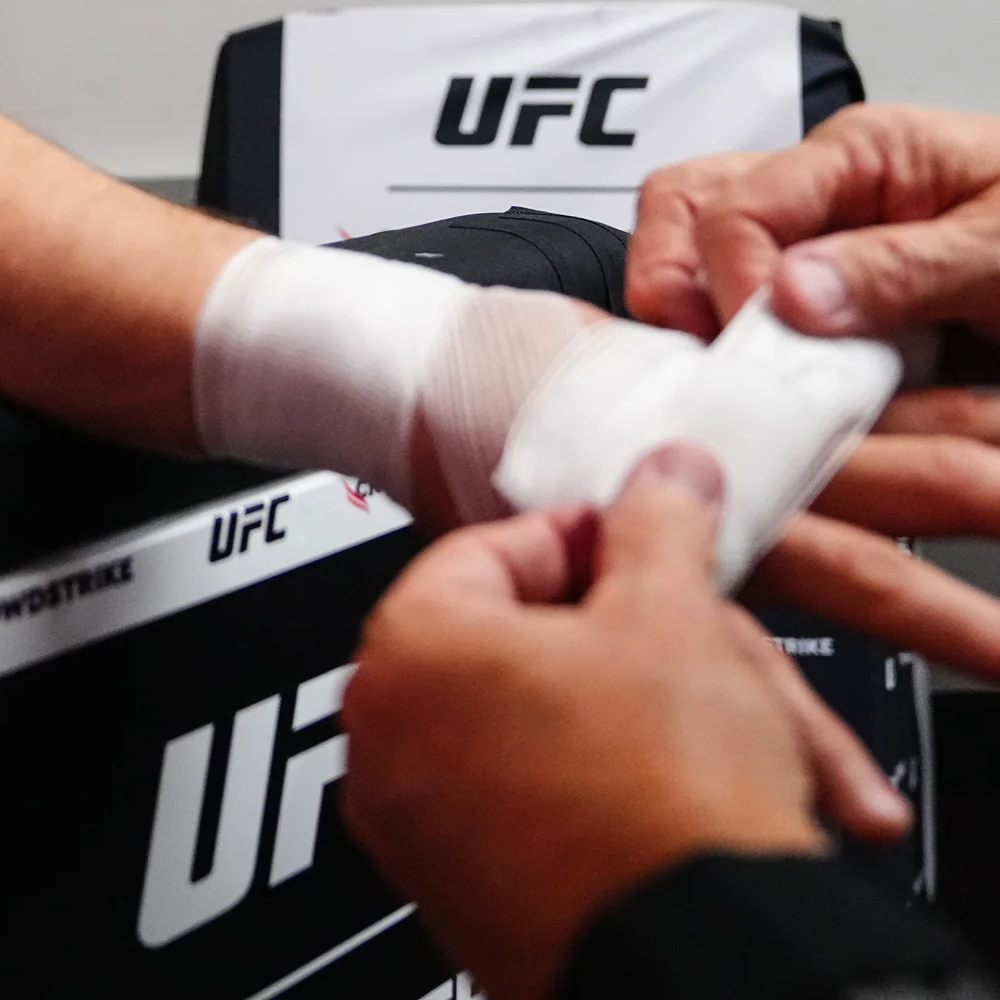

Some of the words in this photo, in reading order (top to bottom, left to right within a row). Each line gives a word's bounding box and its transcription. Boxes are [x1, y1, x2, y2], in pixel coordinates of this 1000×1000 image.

[434, 75, 649, 147] UFC
[208, 494, 290, 563] UFC
[136, 661, 361, 949] UF
